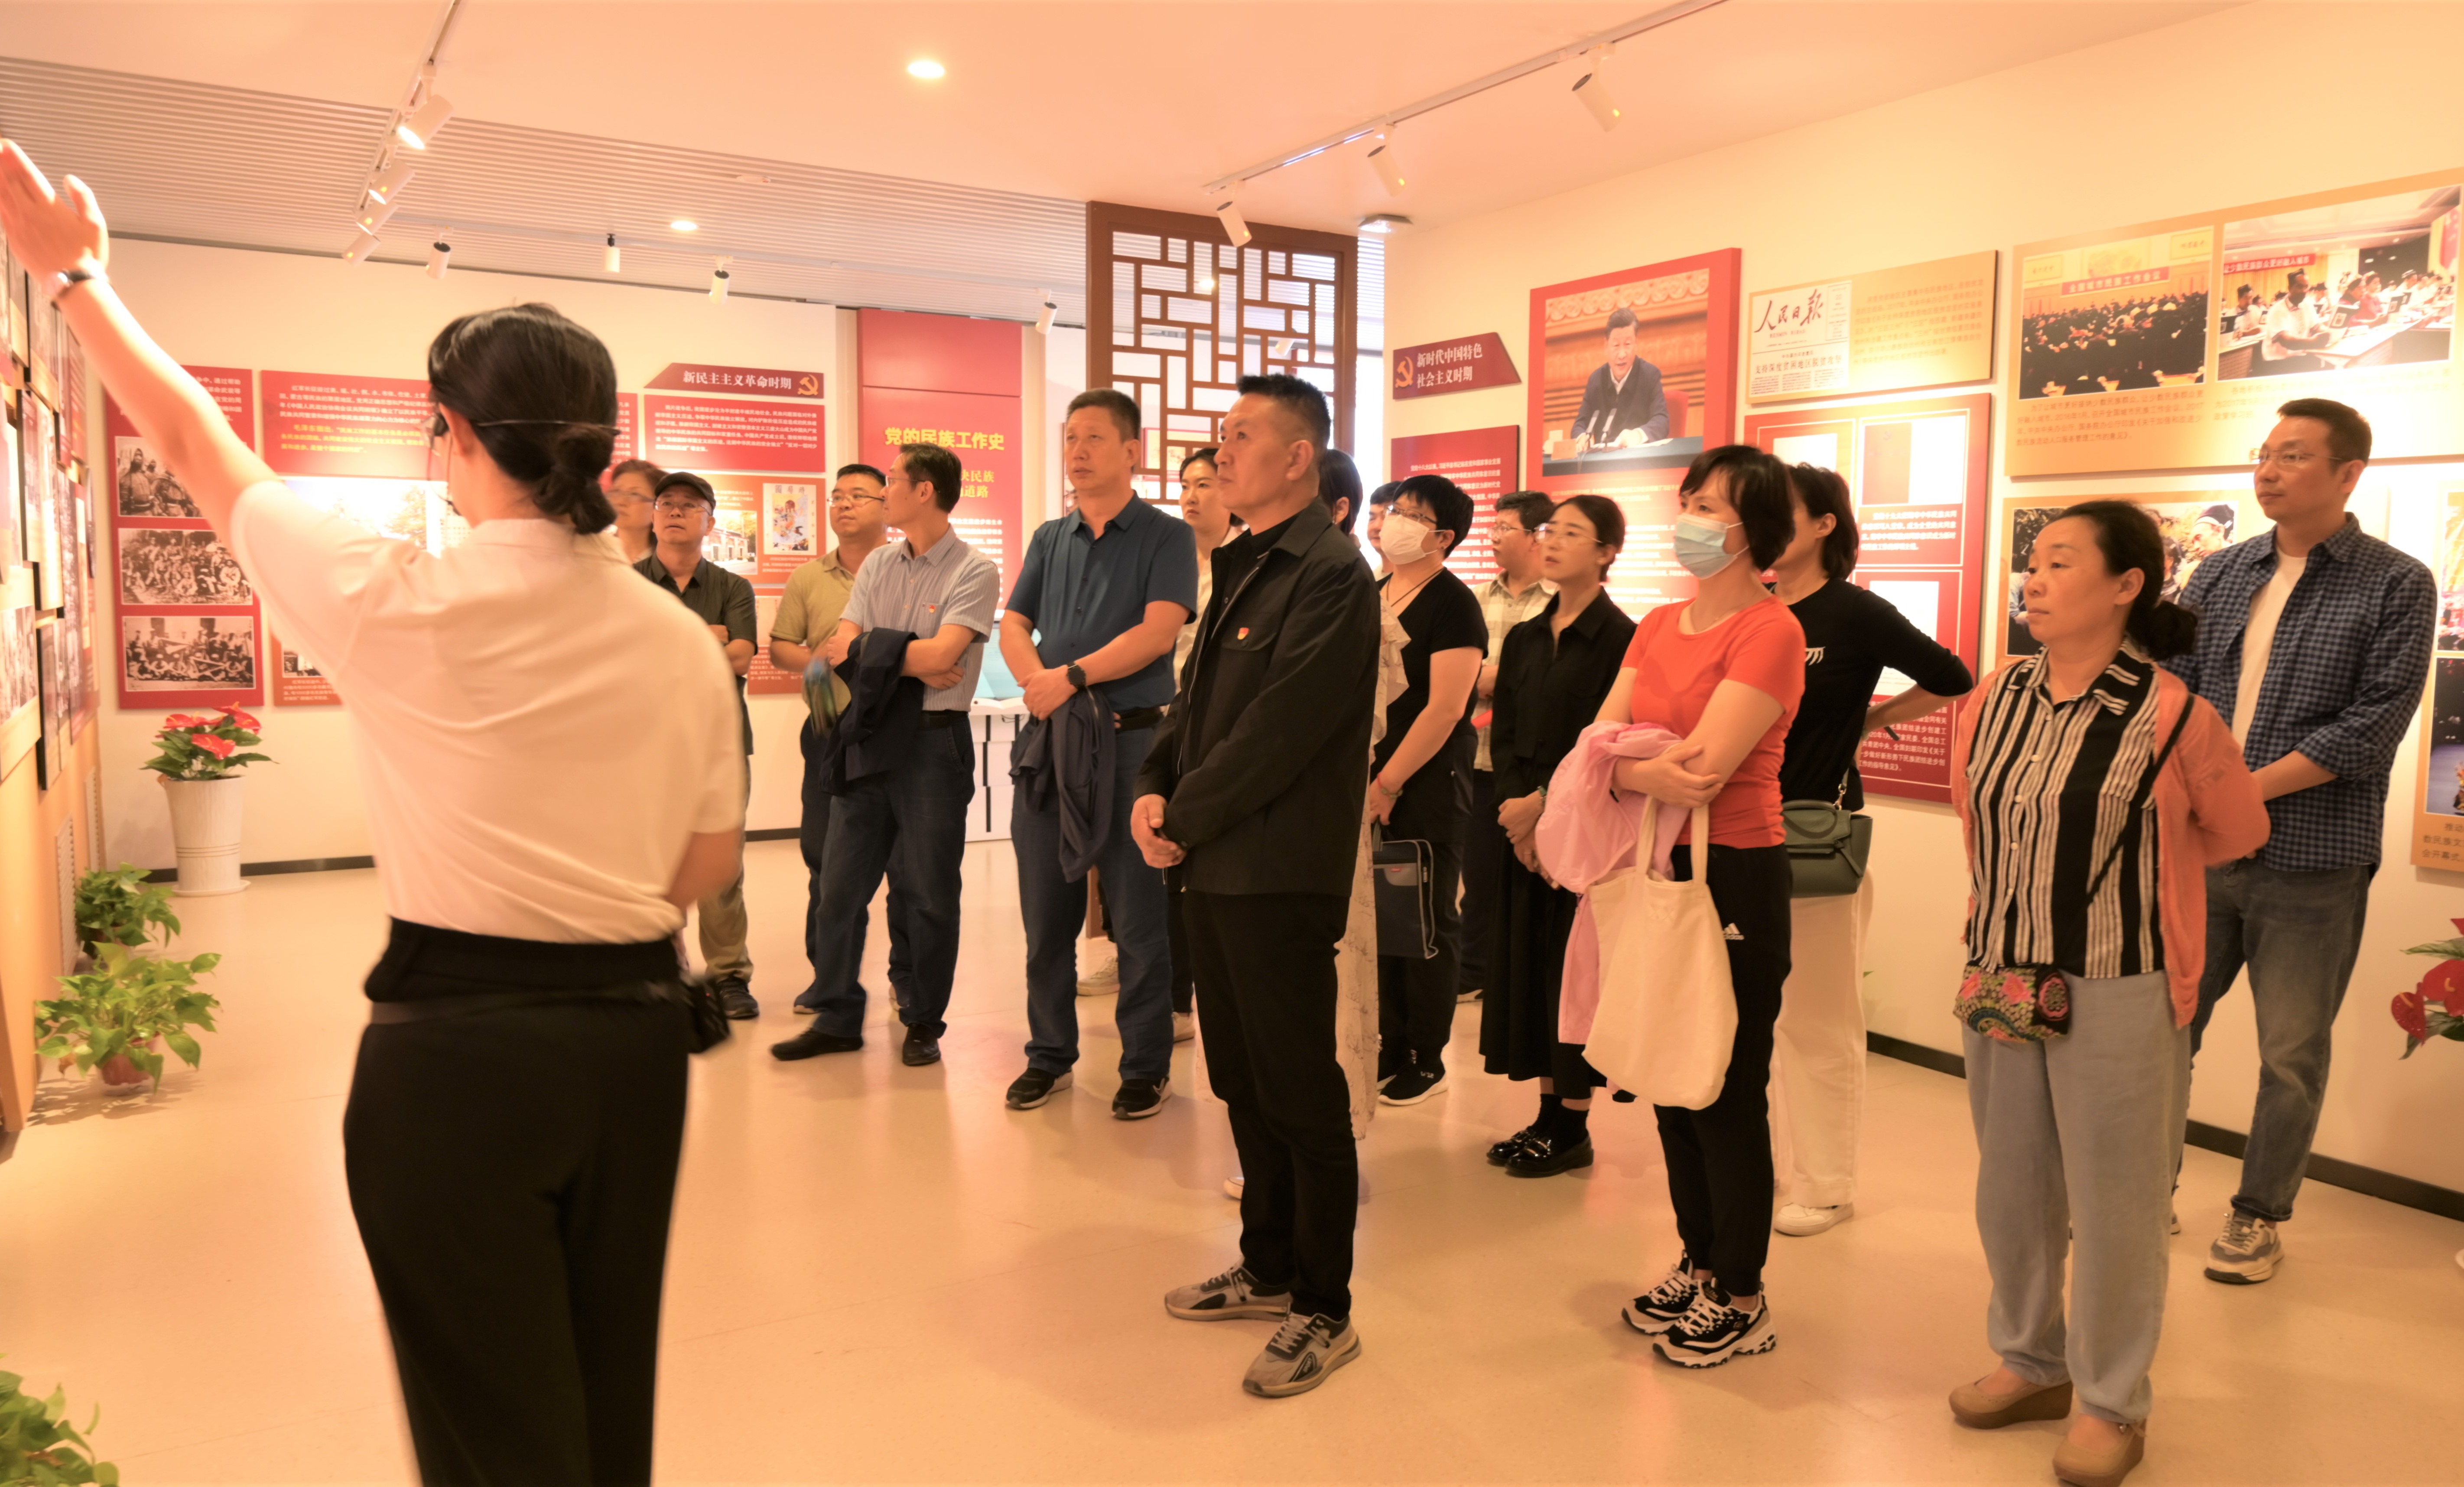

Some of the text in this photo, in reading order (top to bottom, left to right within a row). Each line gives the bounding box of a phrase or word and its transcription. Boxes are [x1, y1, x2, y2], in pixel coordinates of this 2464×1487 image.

[2068, 271, 2161, 293] 全国城市民族工作会议
[1754, 289, 1824, 333] 人民日报
[1416, 343, 1483, 368] 新时代中国特色
[683, 370, 792, 390] 新民主主义革命时期
[1416, 366, 1473, 388] 社会主义时期
[884, 427, 1004, 451] 党的民族工作史
[959, 484, 989, 498] 道路
[2423, 834, 2464, 847] 数民族文
